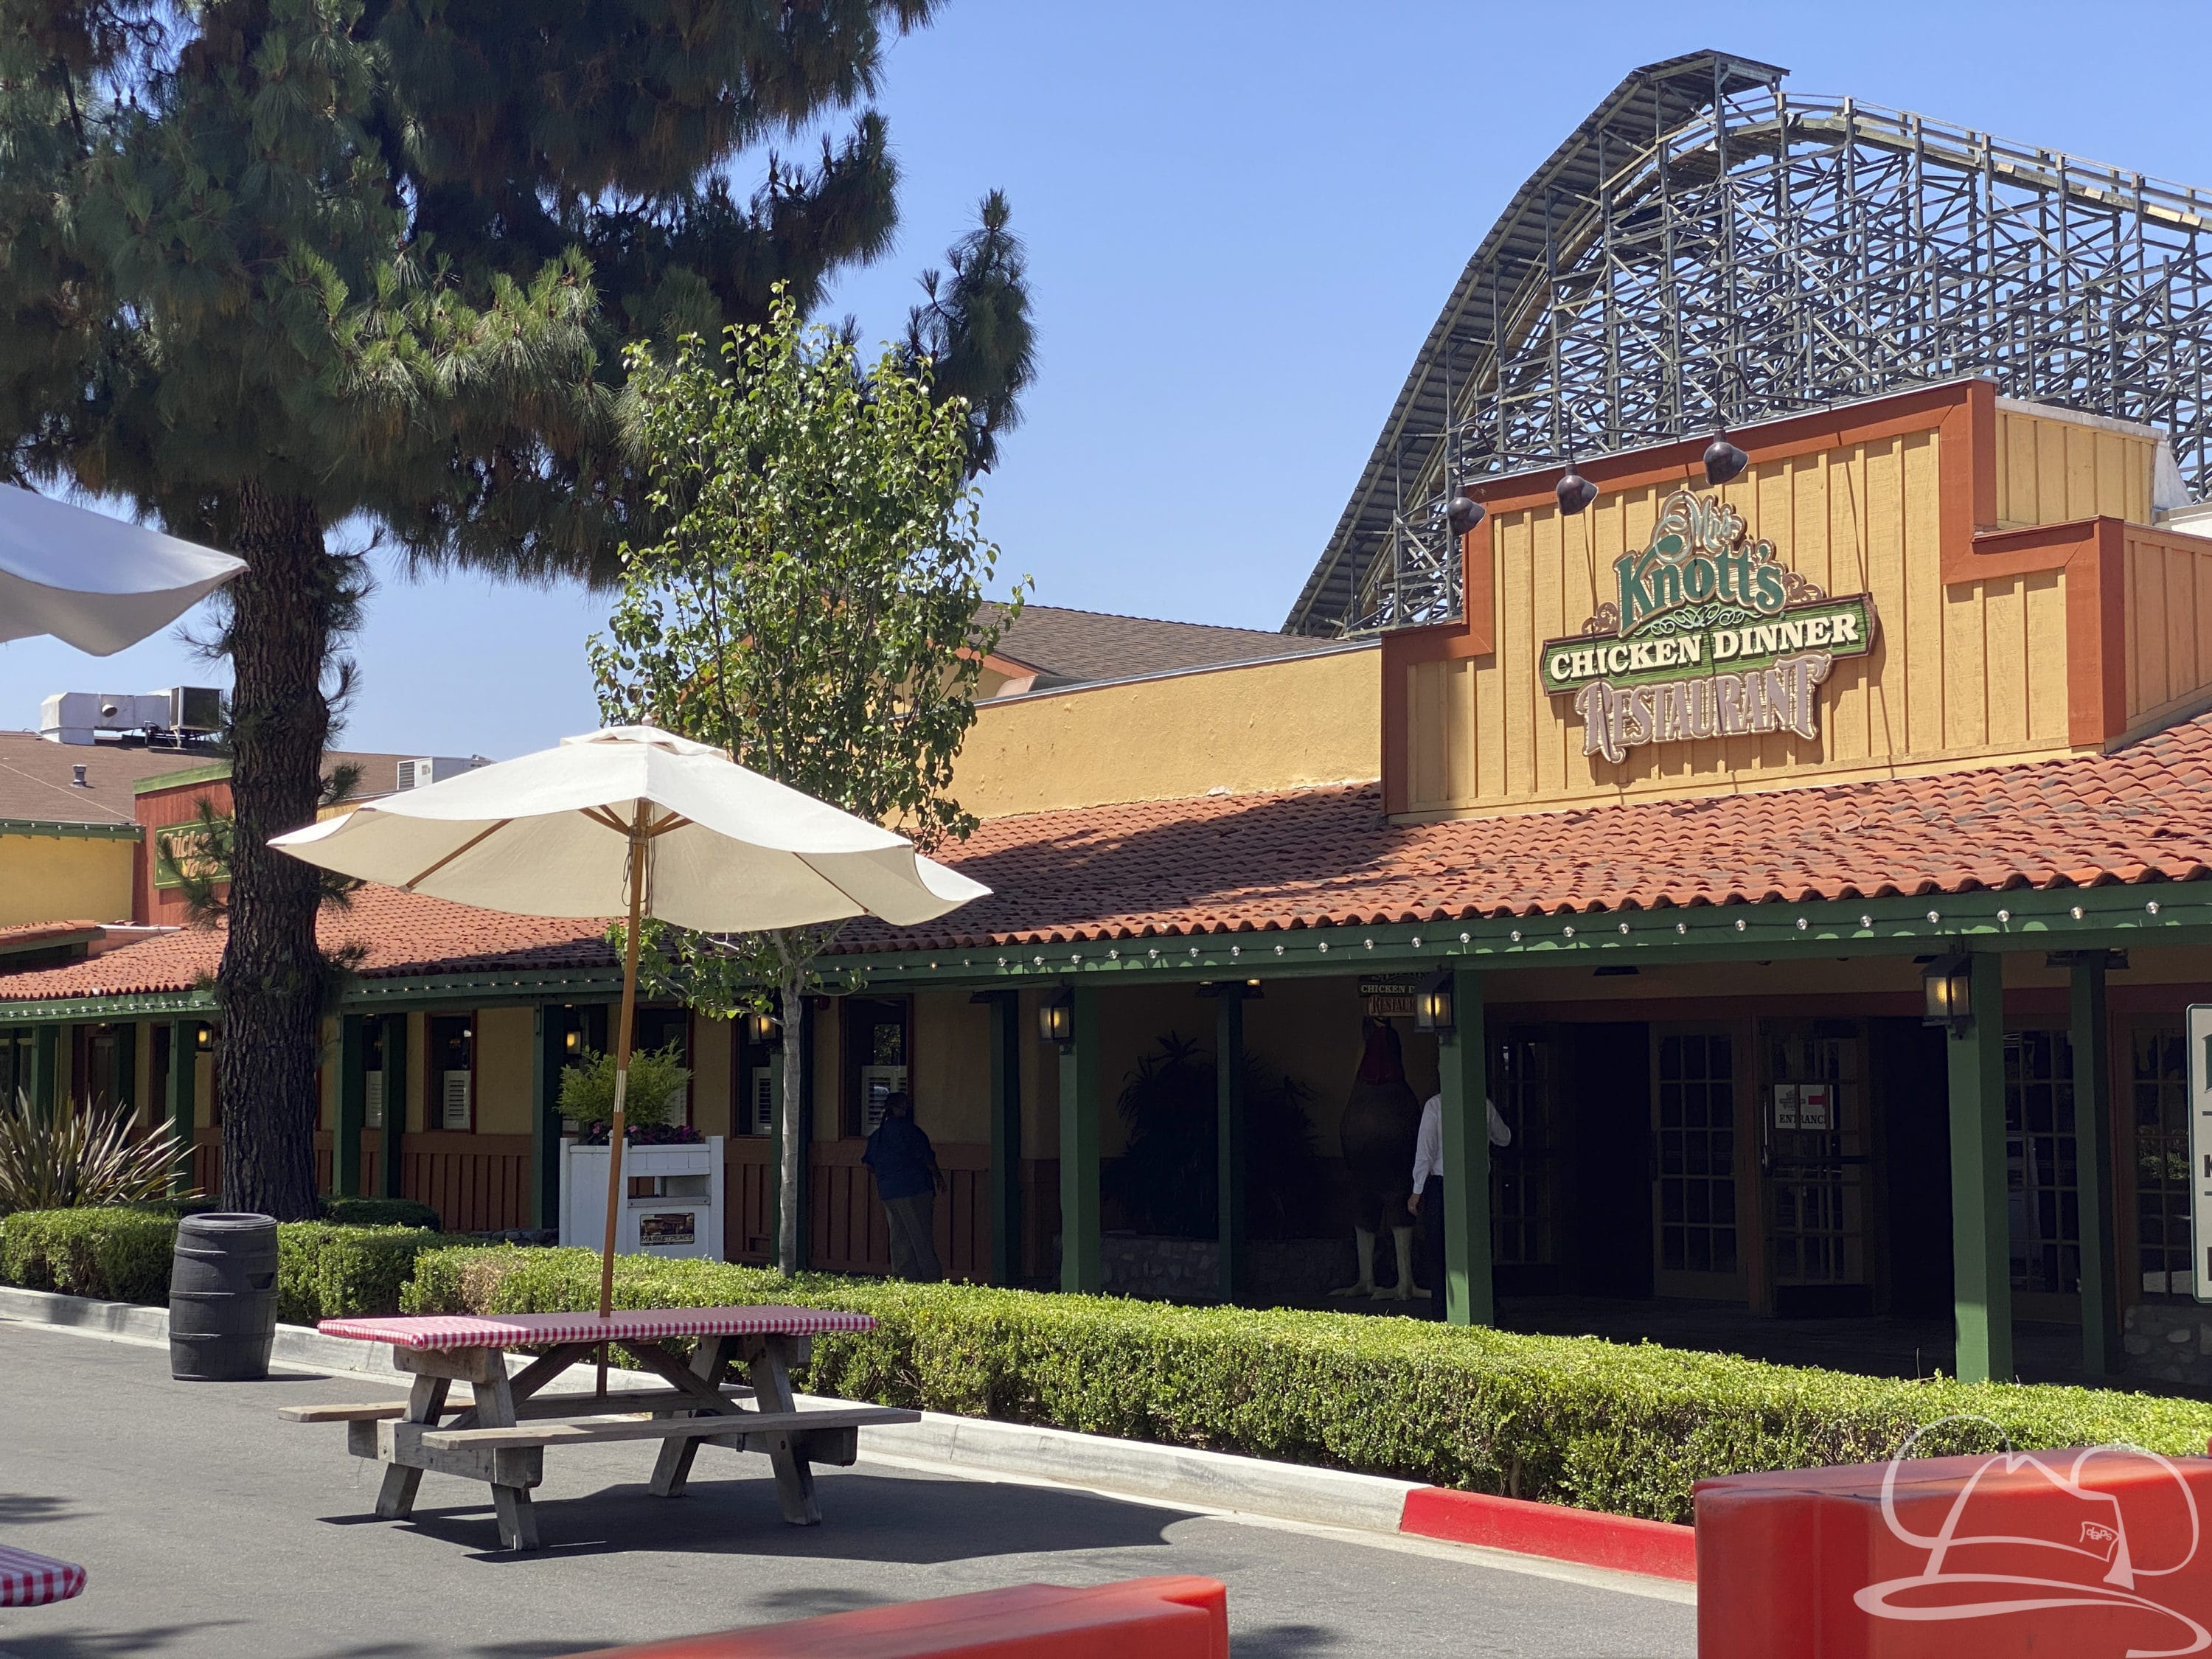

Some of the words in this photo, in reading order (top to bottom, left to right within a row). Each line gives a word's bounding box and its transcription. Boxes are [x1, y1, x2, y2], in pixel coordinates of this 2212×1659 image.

[1615, 534, 1784, 630] Knott's
[1550, 636, 1701, 680] CHICKEN
[1713, 613, 1859, 658] DINNER
[1576, 653, 1831, 762] RESTAURANT
[1361, 985, 1405, 993] CHICKEN
[1369, 995, 1416, 1014] RESTAUR
[1780, 1114, 1826, 1124] ENTRANC
[641, 1234, 693, 1242] MARKETPLACE
